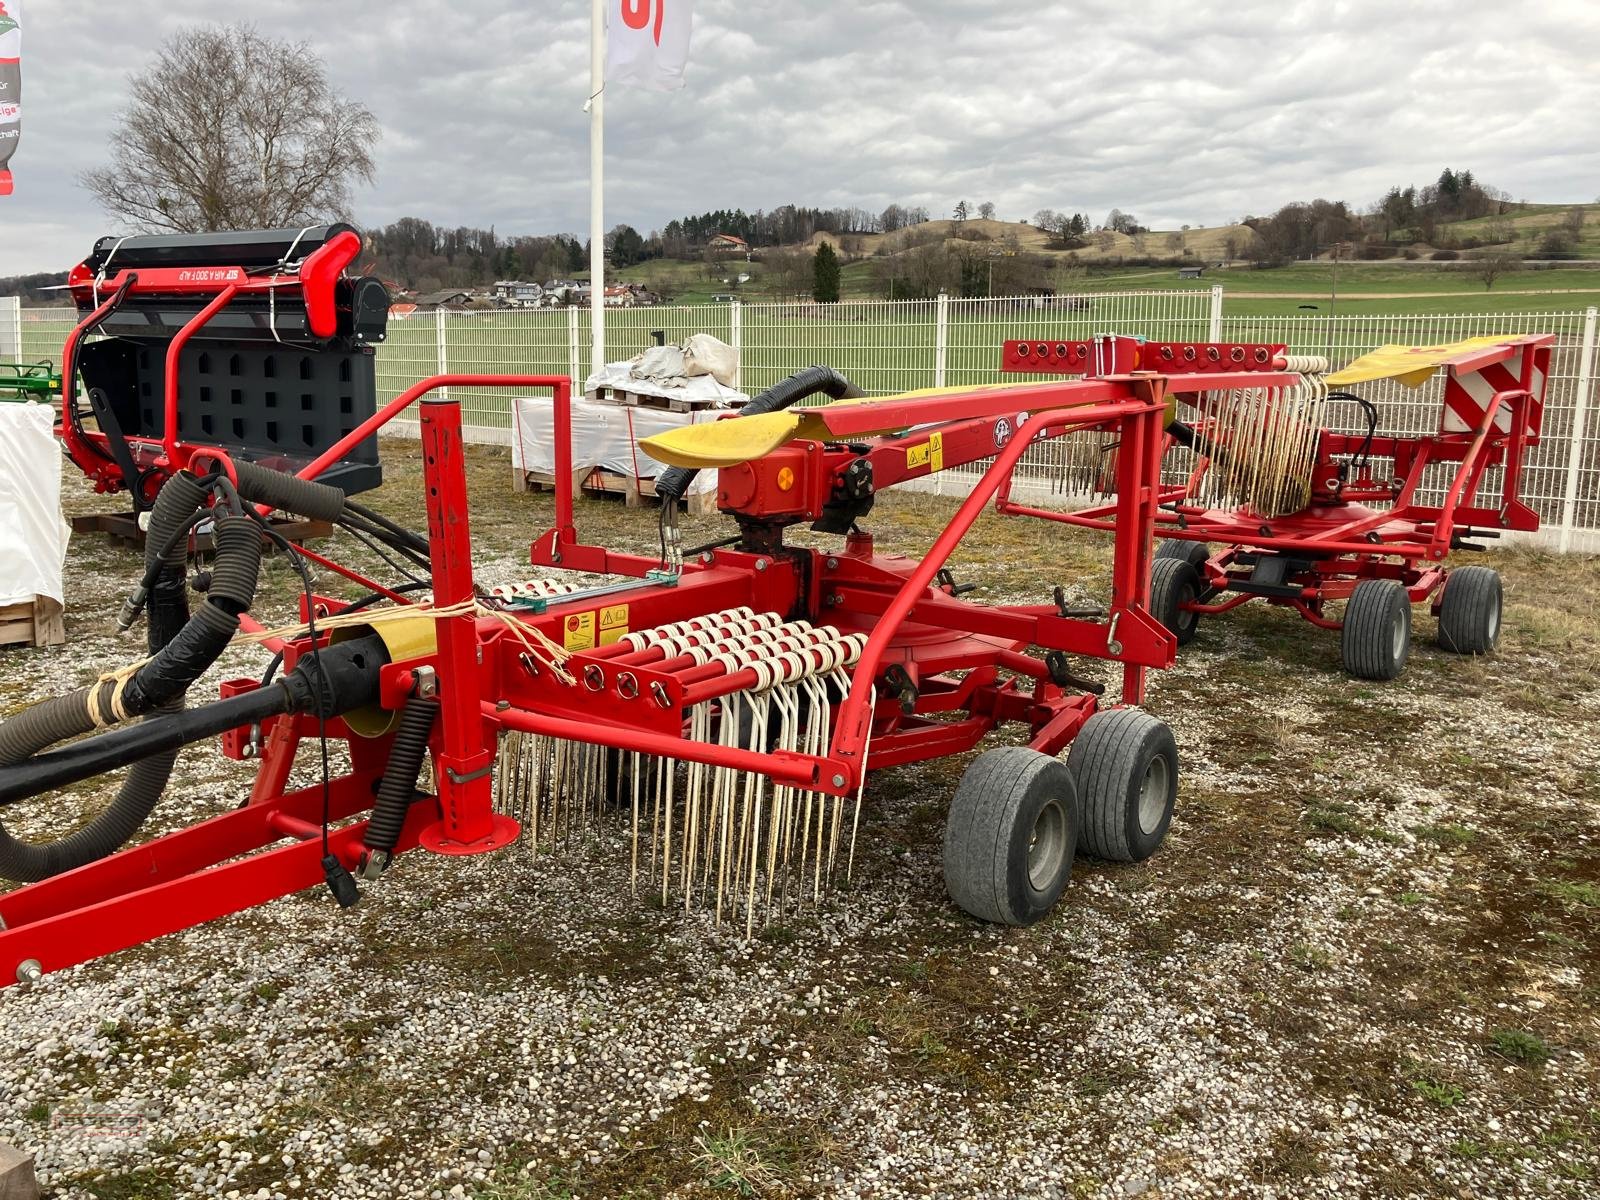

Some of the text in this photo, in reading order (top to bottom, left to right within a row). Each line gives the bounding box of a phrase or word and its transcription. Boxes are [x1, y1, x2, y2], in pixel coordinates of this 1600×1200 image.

[0, 81, 8, 90] ür
[179, 271, 191, 281] ALP
[195, 270, 209, 281] 300
[214, 270, 225, 280] AIR
